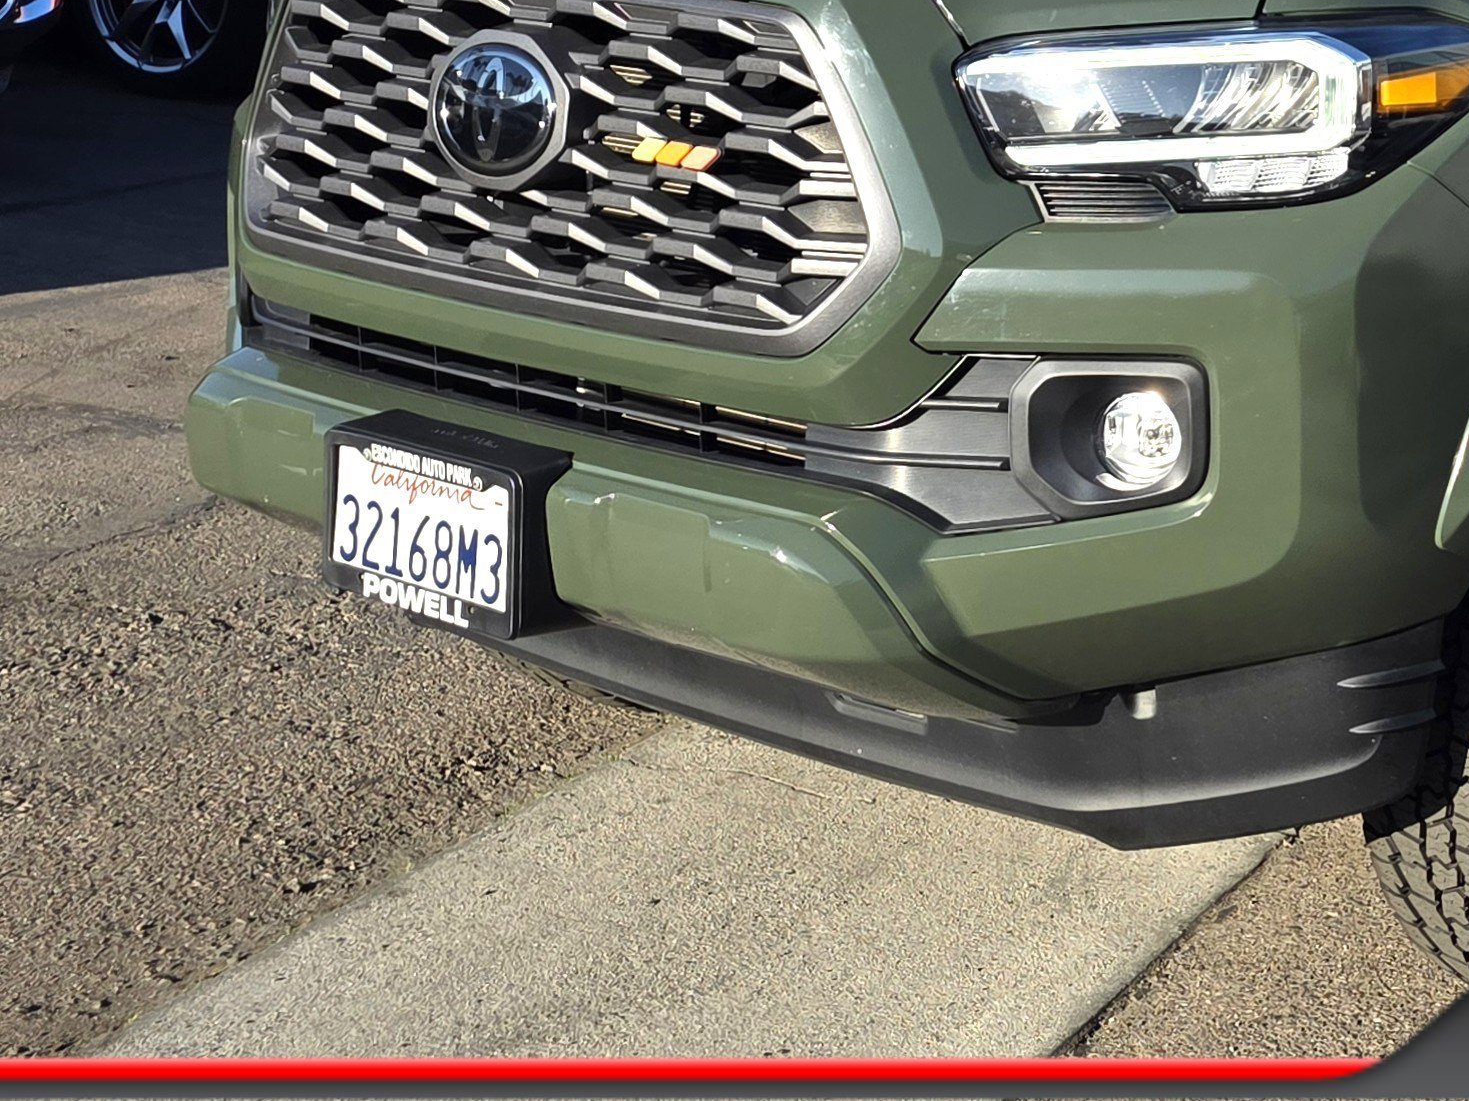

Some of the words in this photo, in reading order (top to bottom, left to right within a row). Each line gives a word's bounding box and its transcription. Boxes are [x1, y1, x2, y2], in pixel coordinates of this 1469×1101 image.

[371, 463, 485, 511] California
[421, 456, 446, 481] AUTO
[446, 462, 473, 488] PARK
[339, 493, 503, 605] 32168M3
[361, 572, 470, 629] POWELL
